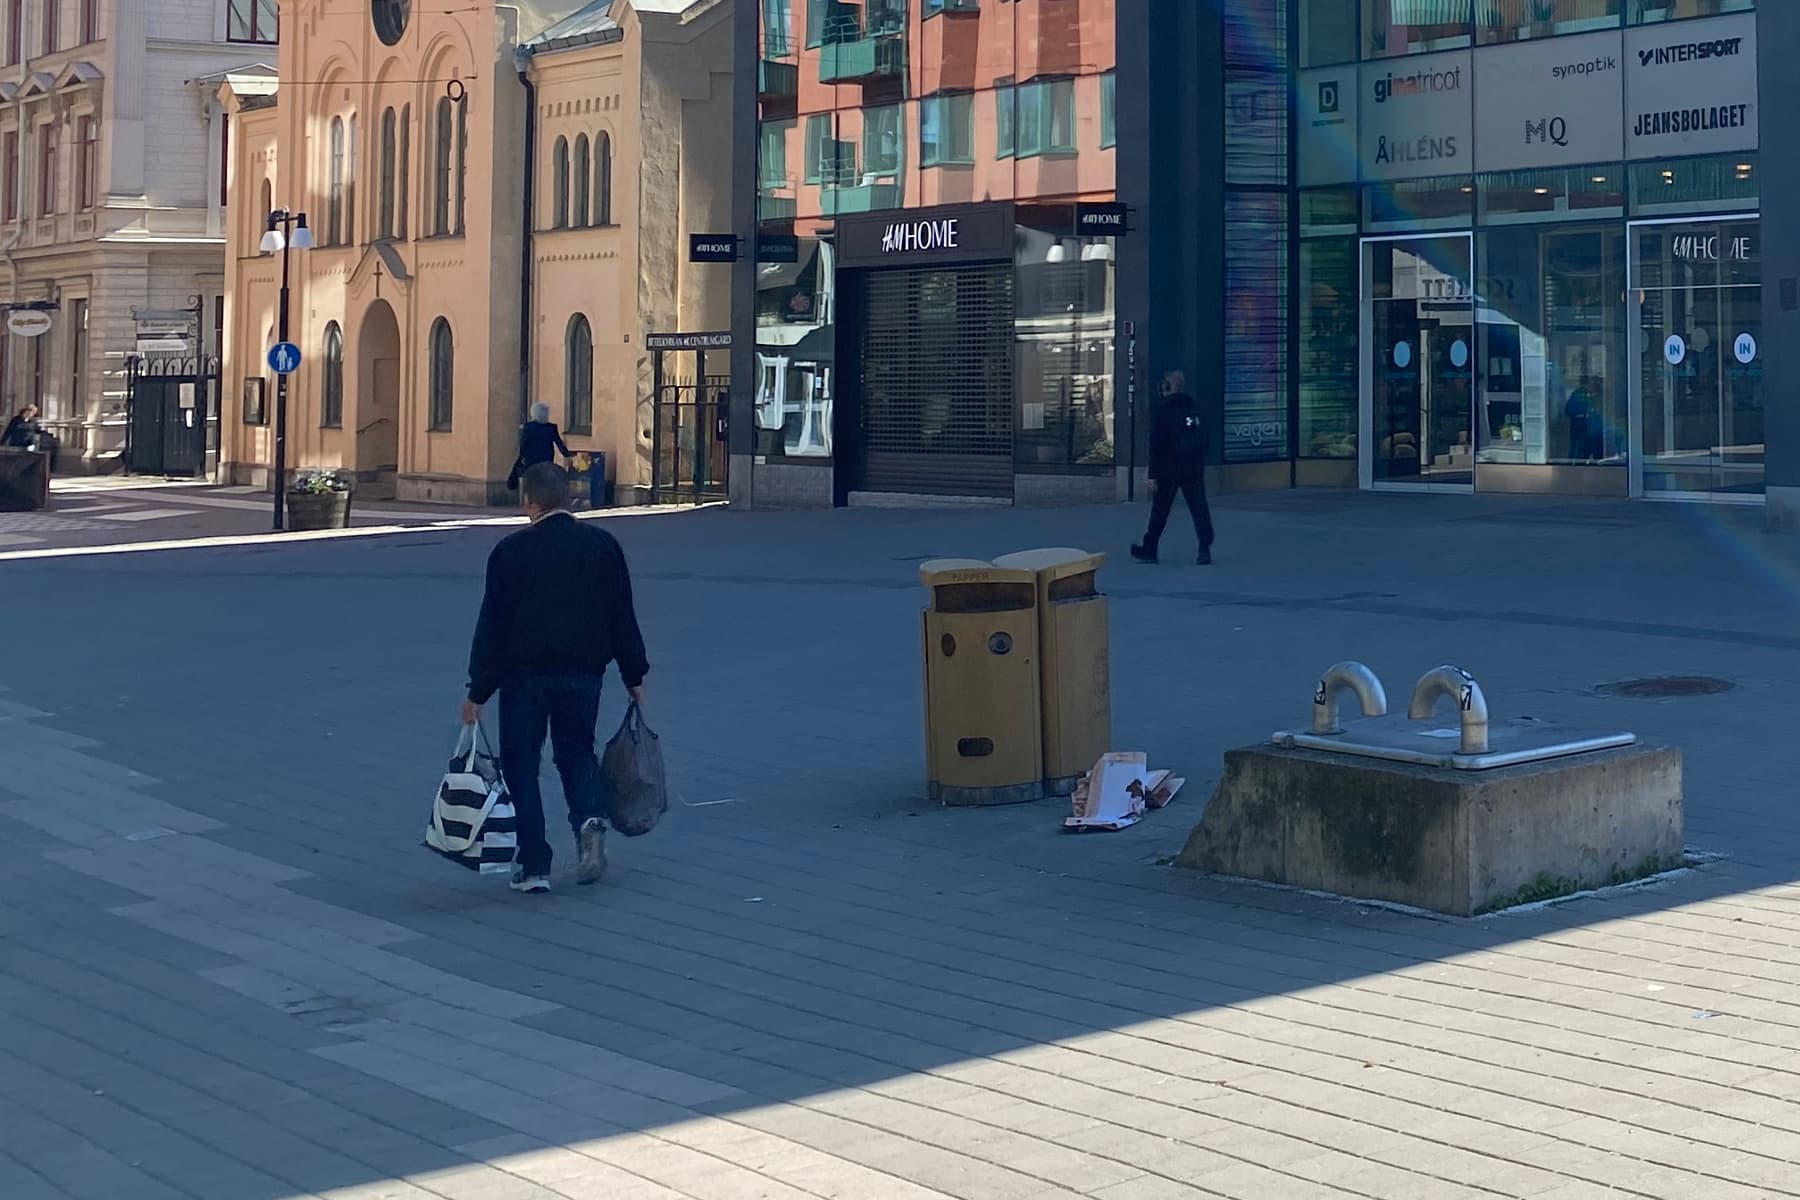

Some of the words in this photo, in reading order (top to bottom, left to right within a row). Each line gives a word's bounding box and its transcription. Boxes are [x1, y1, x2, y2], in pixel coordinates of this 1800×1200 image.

[1654, 37, 1742, 65] INTERSPORT
[1552, 57, 1616, 80] synoptik
[1525, 116, 1569, 147] MQ
[1633, 104, 1747, 137] JEANSBOLAGET
[1375, 135, 1457, 165] ÅHLÉNS
[905, 219, 958, 251] HOME
[1669, 344, 1681, 355] IN
[1739, 343, 1751, 354] IN
